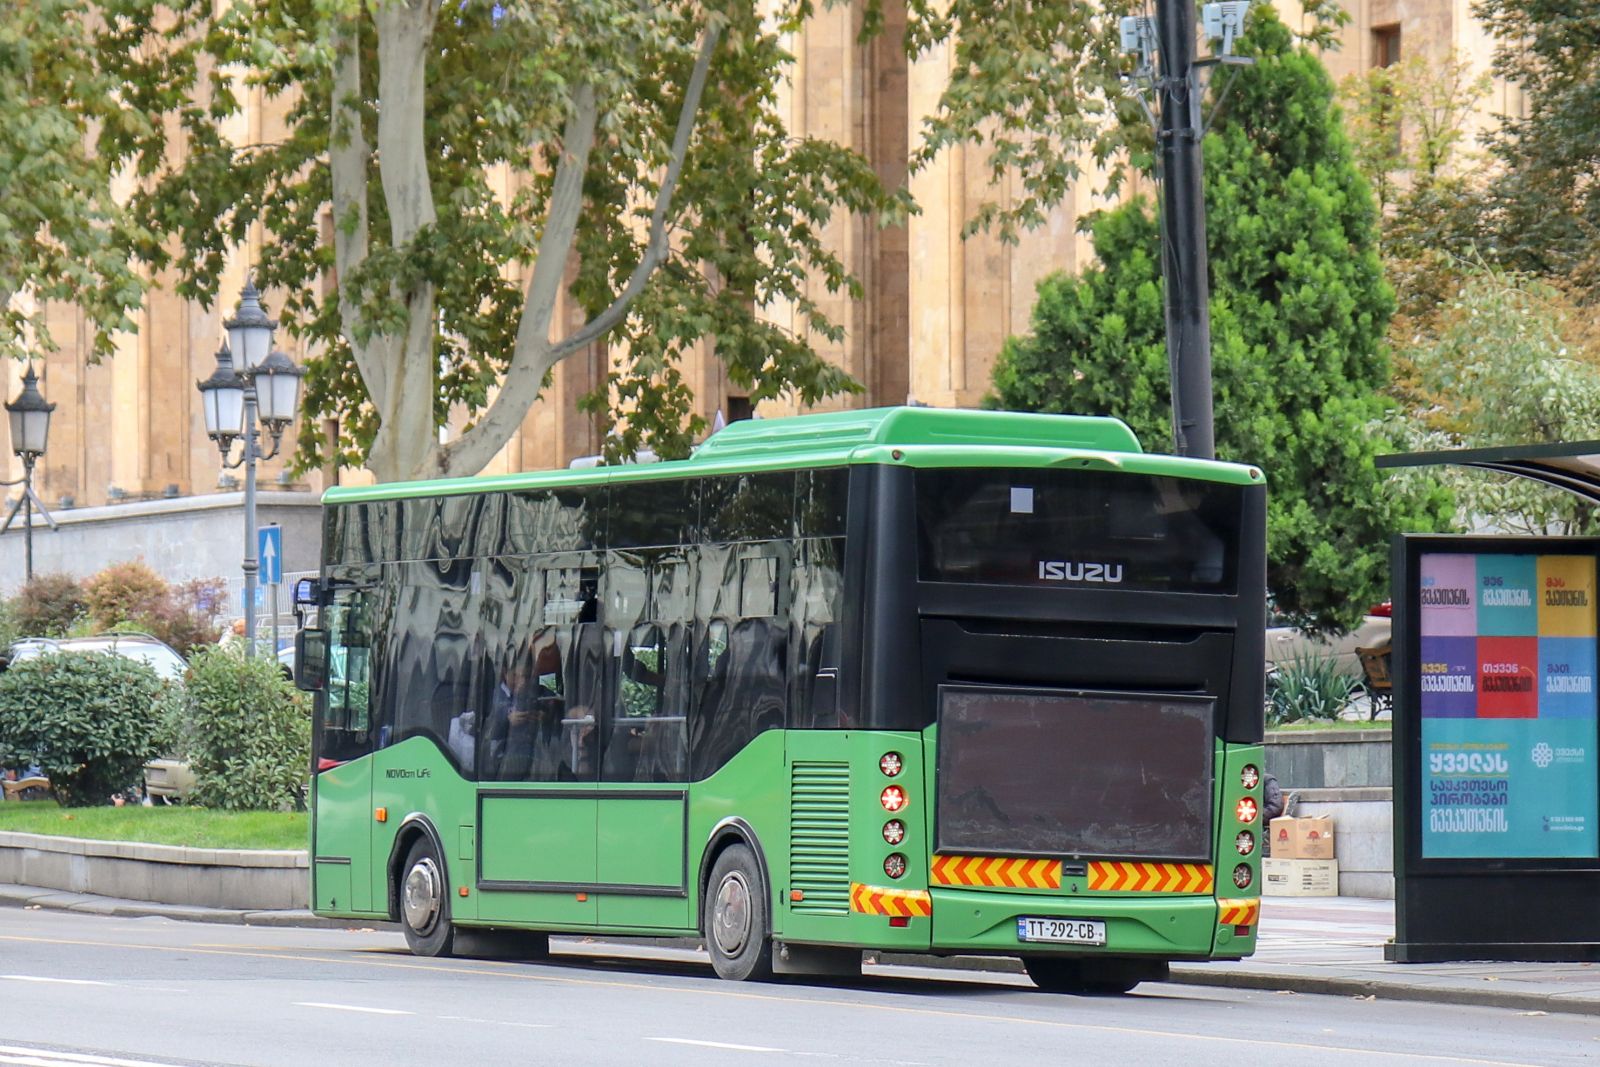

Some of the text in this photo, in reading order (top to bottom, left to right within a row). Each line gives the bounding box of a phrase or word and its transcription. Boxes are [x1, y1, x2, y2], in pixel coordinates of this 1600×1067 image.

[1038, 560, 1123, 583] ISUZU
[1482, 663, 1518, 673] თქვენ
[1429, 752, 1509, 774] ყველას
[1429, 779, 1508, 792] საუკეთესო
[1429, 792, 1508, 806] პირობები
[1430, 807, 1509, 833] გვეკუთვნის
[1028, 920, 1095, 939] TT-292-CB
